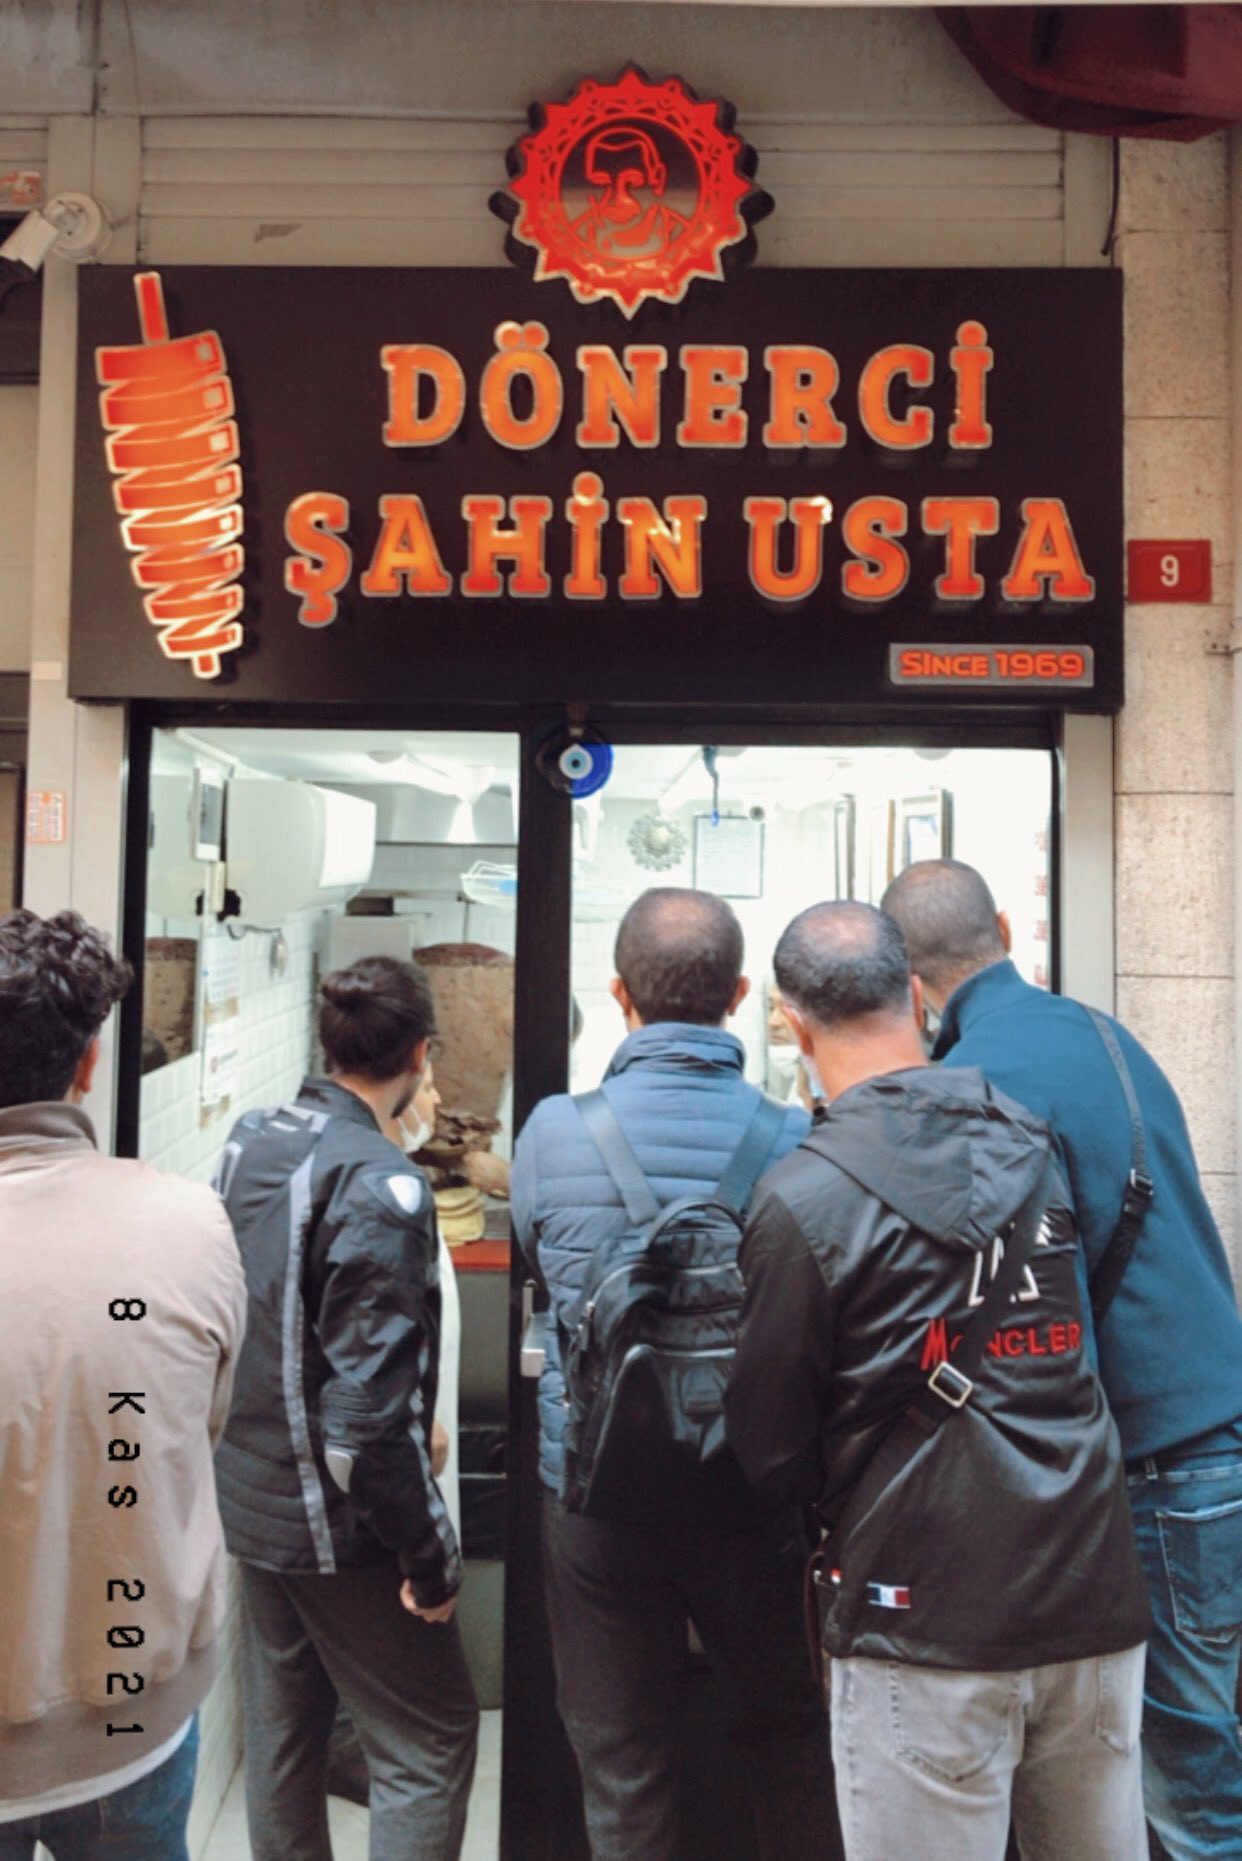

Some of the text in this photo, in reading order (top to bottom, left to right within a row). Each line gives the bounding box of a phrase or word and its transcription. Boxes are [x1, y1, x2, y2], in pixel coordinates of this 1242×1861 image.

[380, 321, 993, 450] DÖNERCİ
[285, 471, 1096, 628] ŞAHİN USTA
[1160, 555, 1180, 588] 9
[901, 651, 1085, 679] SINCE 1969
[920, 1318, 1082, 1371] MNCLER
